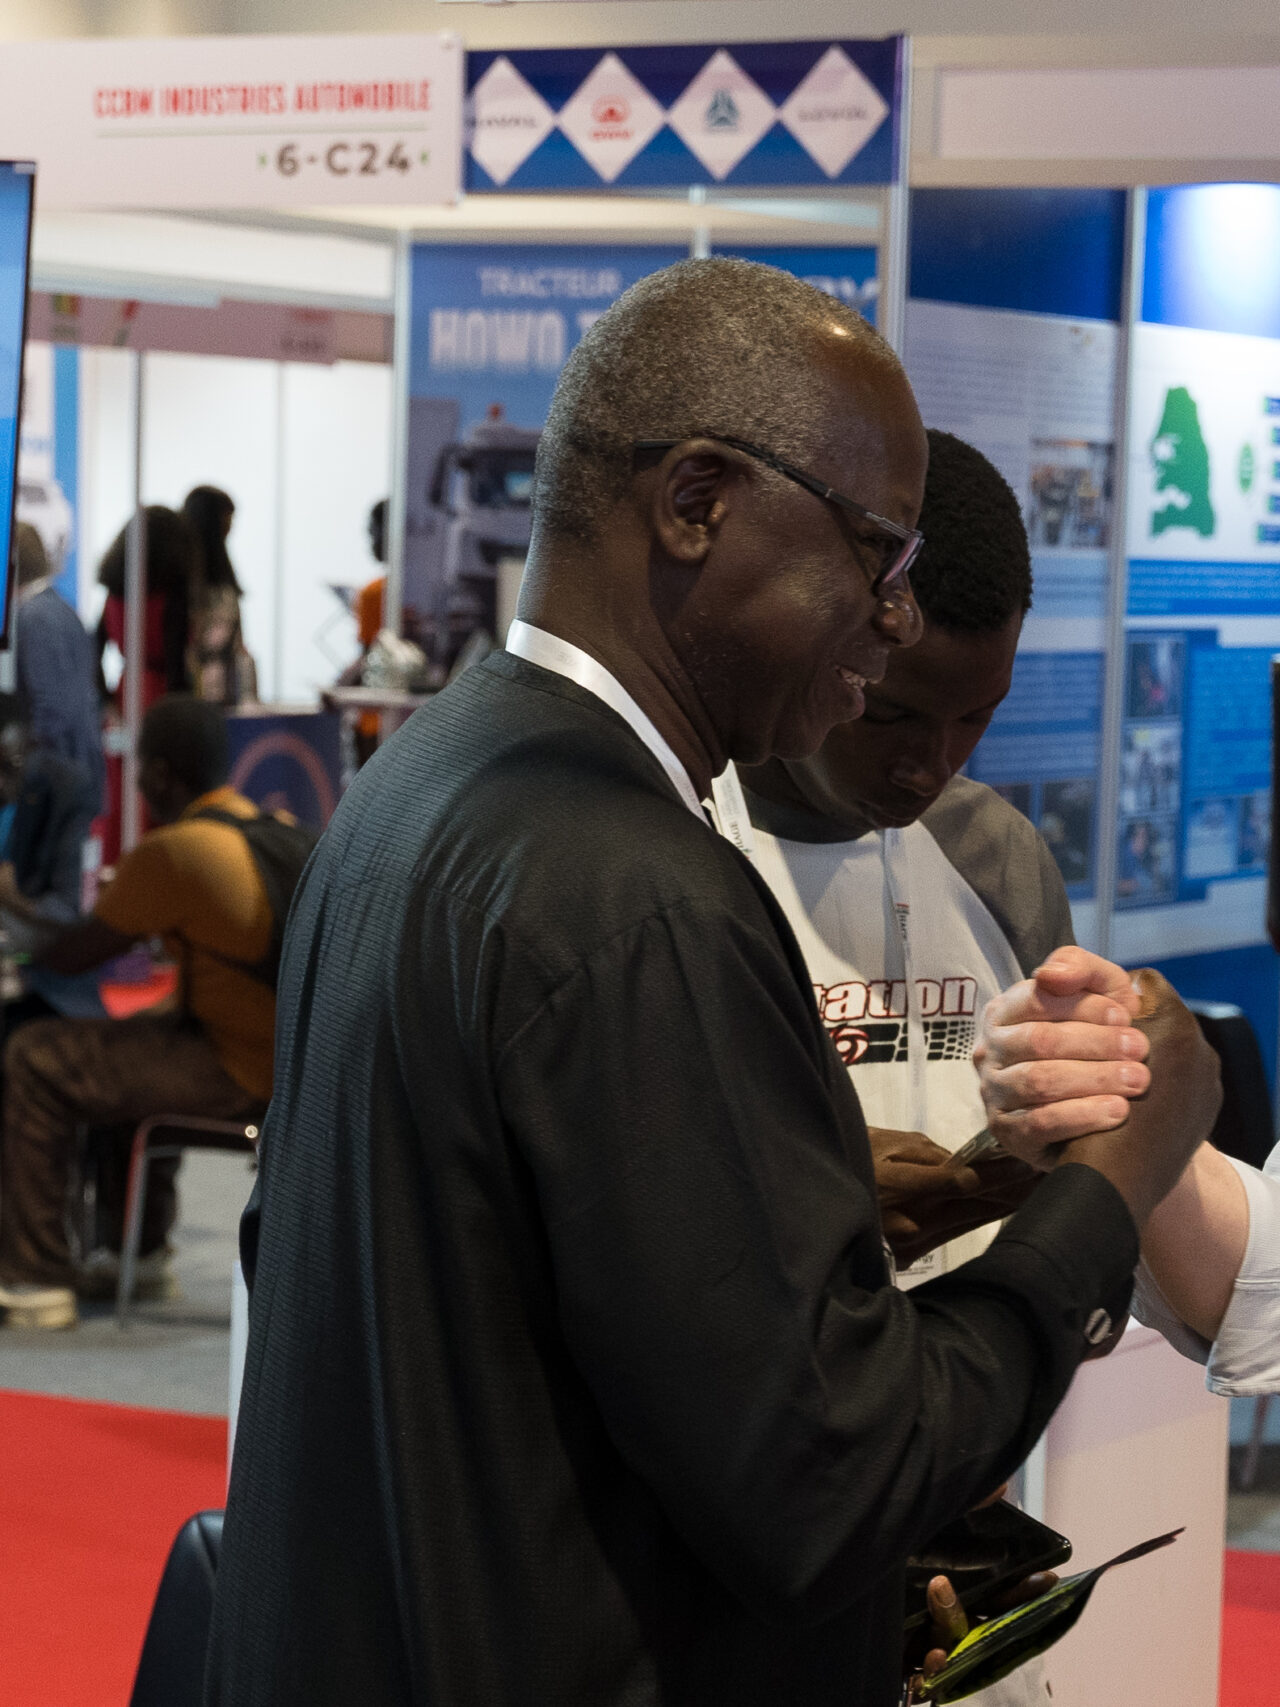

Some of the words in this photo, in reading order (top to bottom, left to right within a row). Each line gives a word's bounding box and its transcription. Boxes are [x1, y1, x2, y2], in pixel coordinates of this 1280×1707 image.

[161, 83, 286, 116] INDUSTRIES
[294, 79, 431, 113] AUTOMOBILE
[276, 142, 411, 178] 6-C24
[480, 266, 622, 297] TRACTEUR
[430, 310, 566, 371] HOWO
